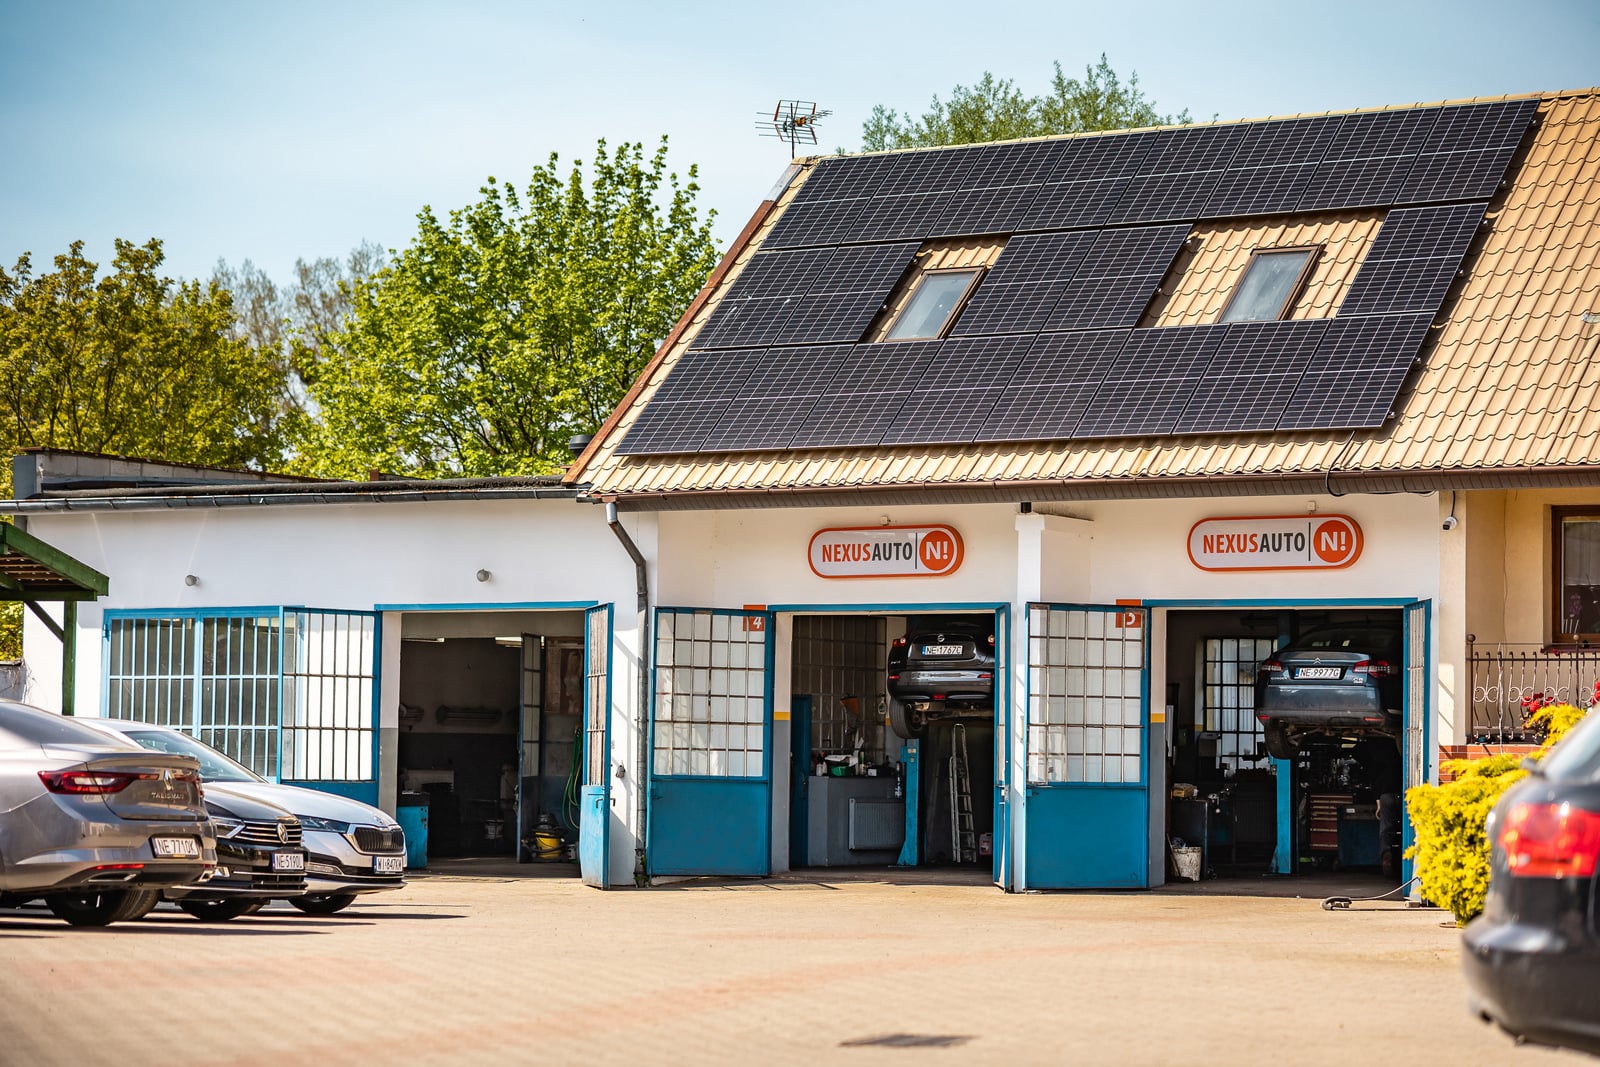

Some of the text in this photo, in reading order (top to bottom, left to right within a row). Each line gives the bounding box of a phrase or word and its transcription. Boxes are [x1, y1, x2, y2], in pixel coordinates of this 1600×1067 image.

[822, 541, 949, 563] NEXUSAUTO N!
[1203, 531, 1347, 554] NEXUSAUTO N!
[752, 616, 762, 629] 4
